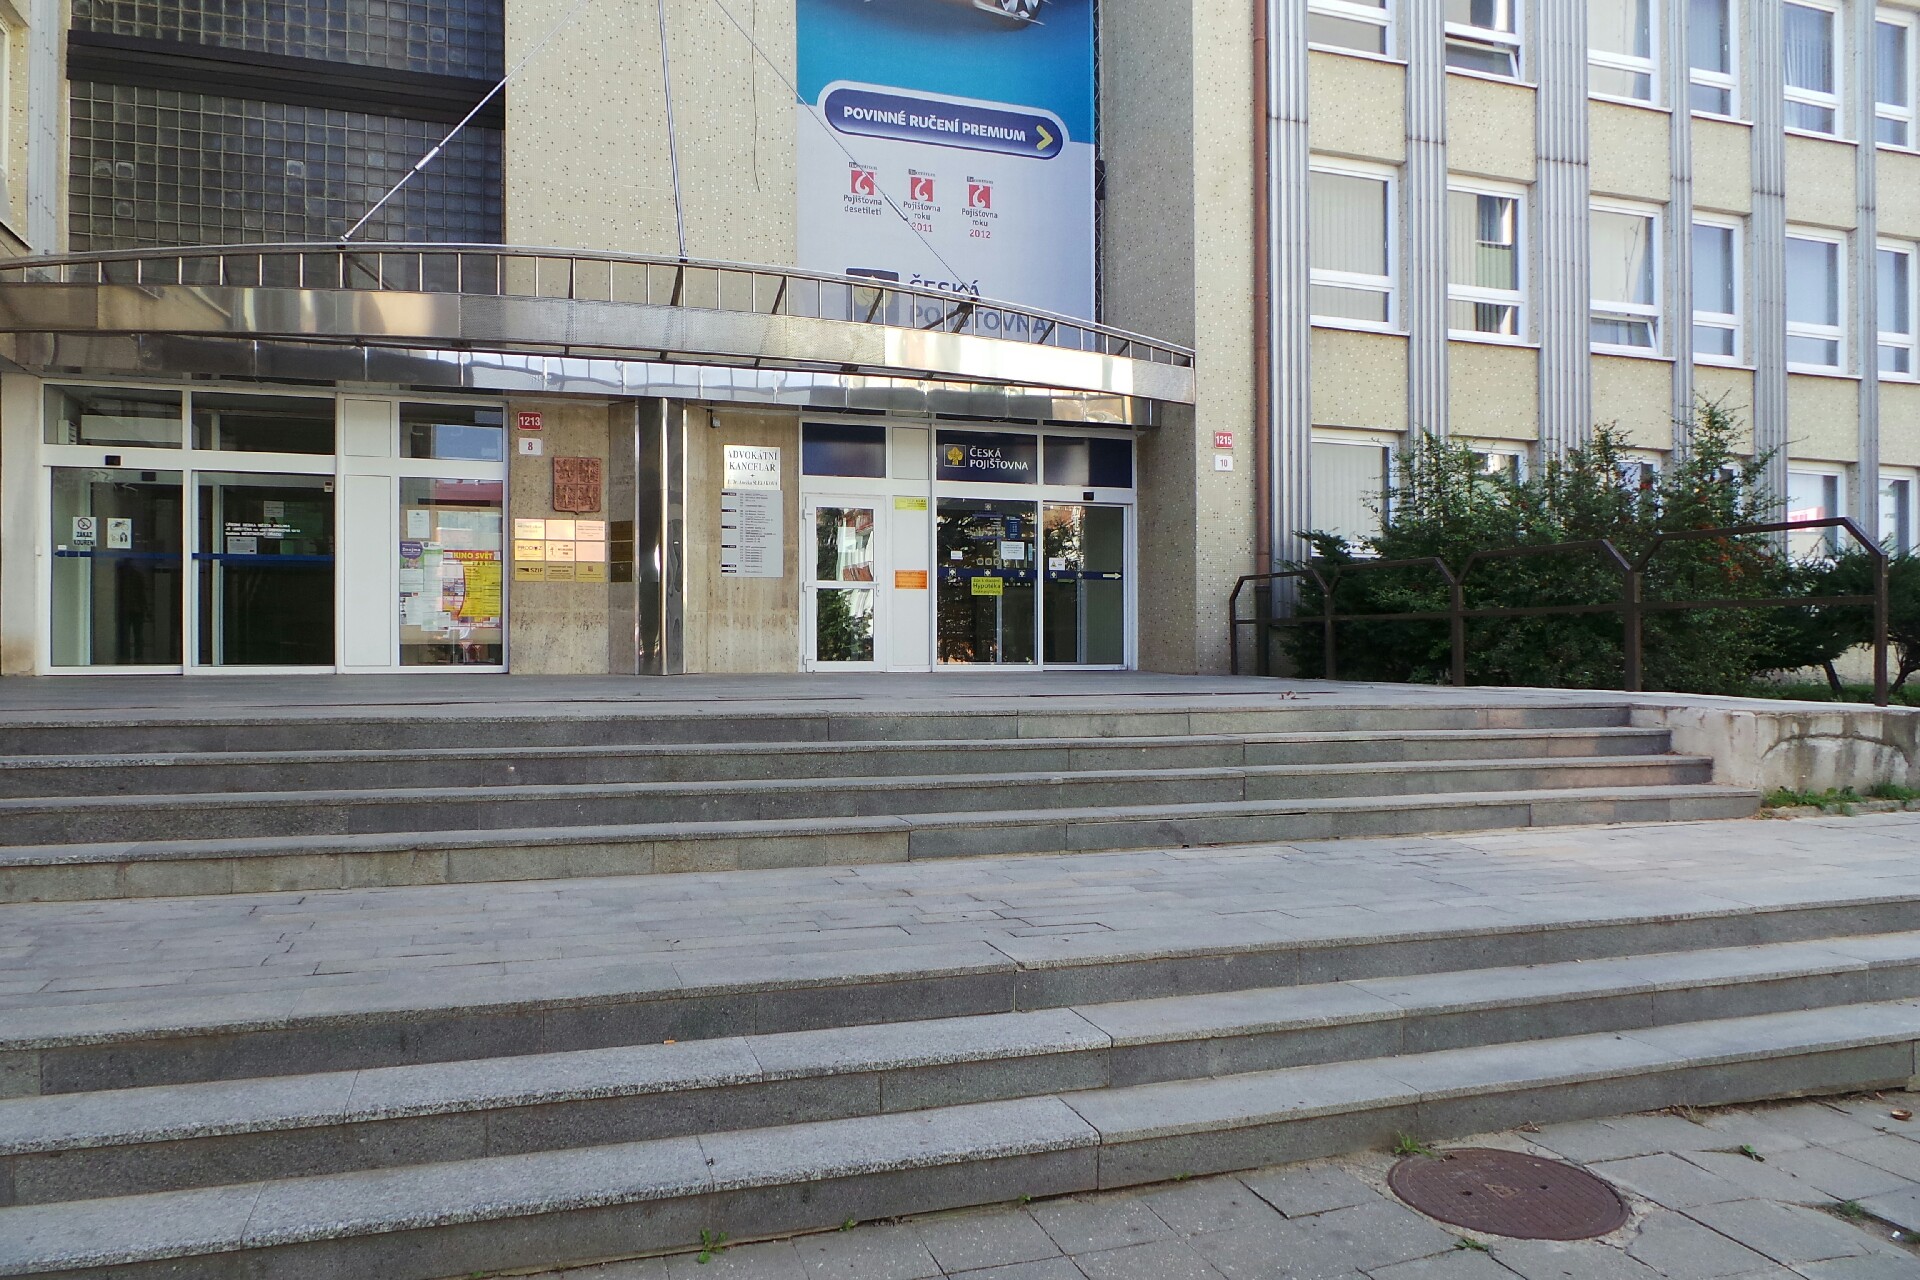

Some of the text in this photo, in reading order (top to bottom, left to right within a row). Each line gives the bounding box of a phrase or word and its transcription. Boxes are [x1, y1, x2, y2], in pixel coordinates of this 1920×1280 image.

[843, 105, 1026, 142] POVINNÉ RUČENÍ PREMIUM
[843, 194, 882, 206] Pojišťovna
[844, 204, 882, 216] desetiletí
[903, 201, 941, 213] Pojišťovna
[913, 212, 931, 221] roku
[961, 208, 998, 219] Pojišťovna
[911, 222, 933, 233] 2011
[972, 218, 988, 227] roku
[969, 229, 991, 239] 2012
[909, 304, 1047, 334] POIOVNA
[519, 416, 541, 426] 1213
[527, 441, 534, 451] 8
[1216, 436, 1232, 445] 1215
[728, 450, 777, 461] ADVOKÁTNÍ
[969, 445, 1002, 458] ČESKÁ
[729, 461, 776, 472] KANCELÁŘ
[969, 458, 1029, 471] POJIŠŤOVNA
[1220, 459, 1228, 467] 10
[452, 551, 493, 559] KINO SVĚT
